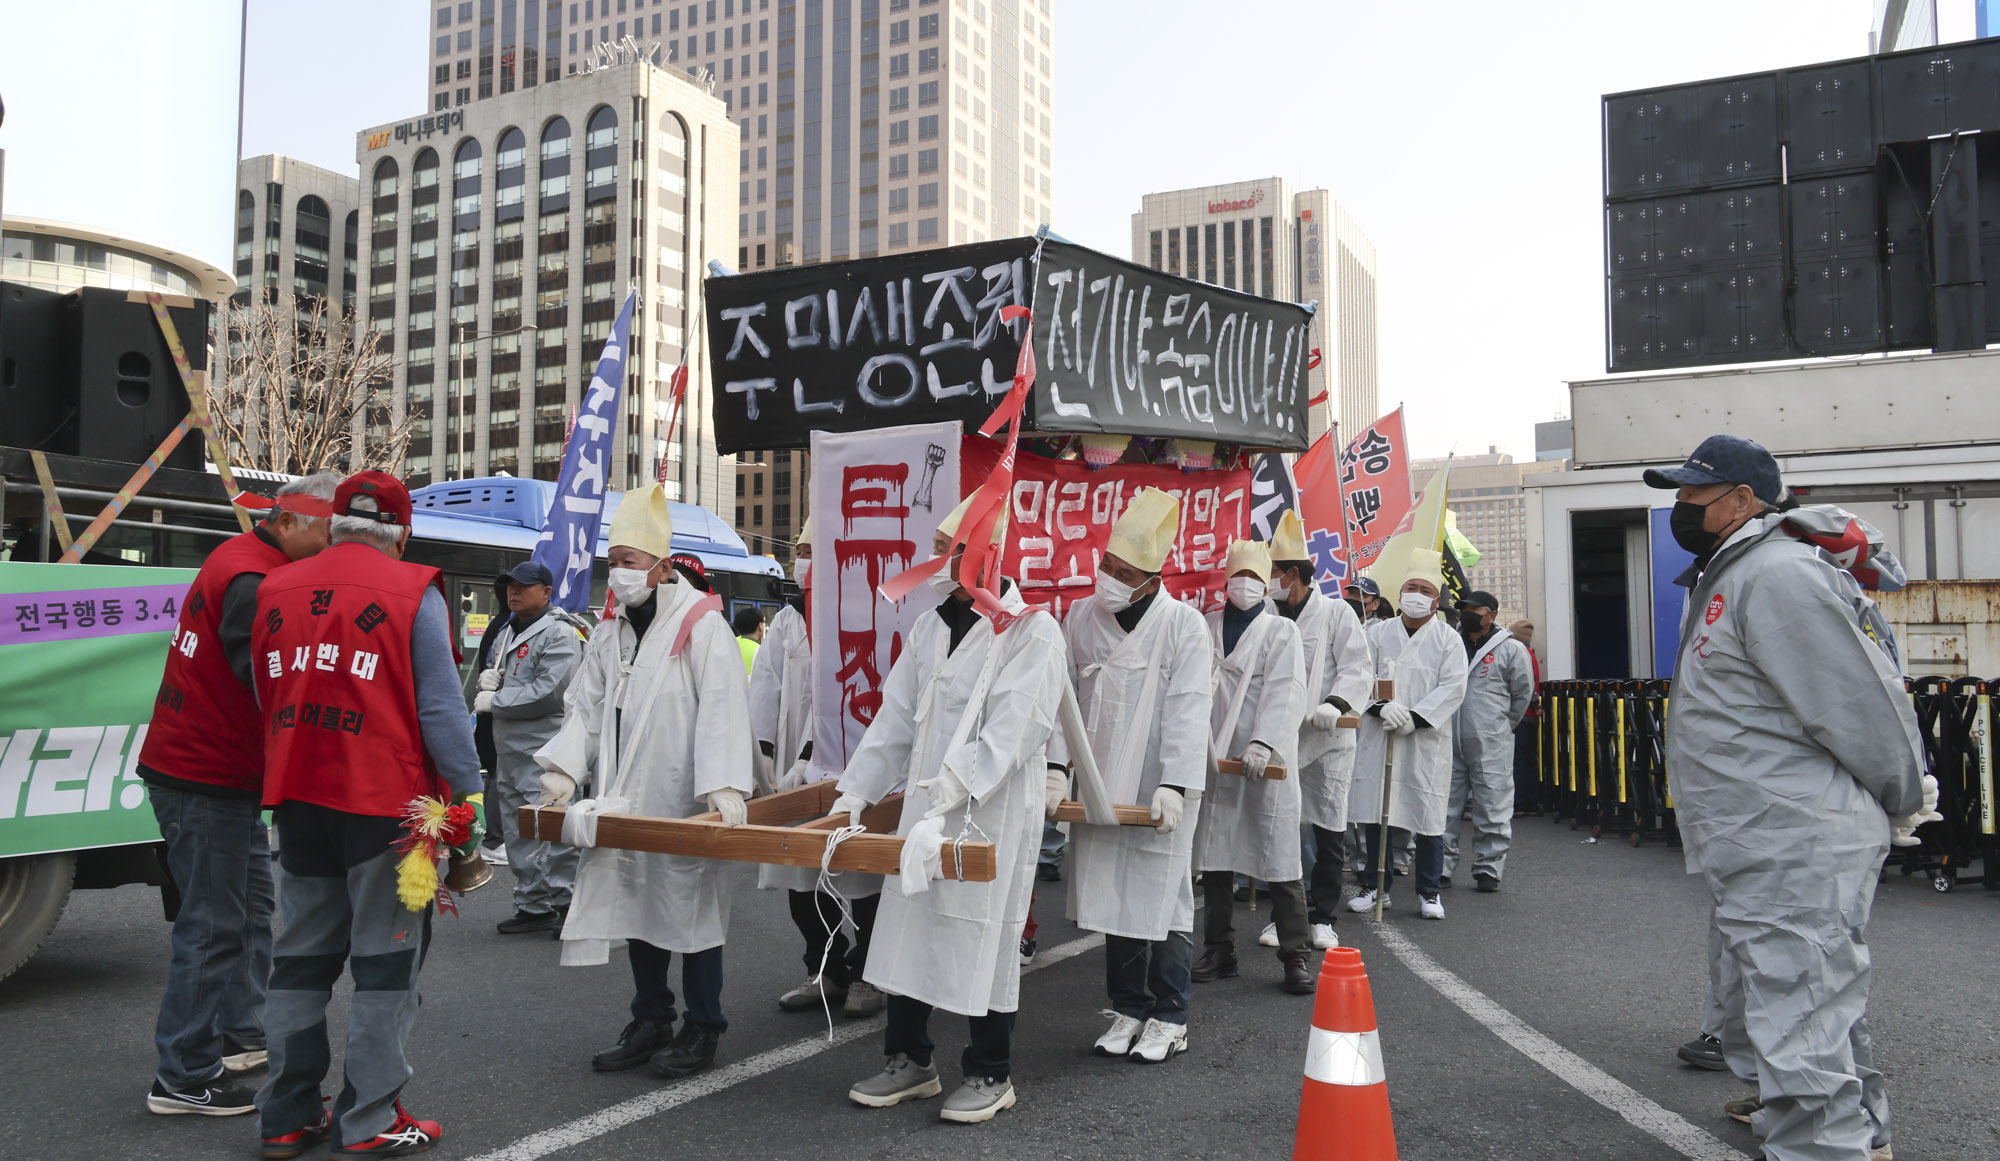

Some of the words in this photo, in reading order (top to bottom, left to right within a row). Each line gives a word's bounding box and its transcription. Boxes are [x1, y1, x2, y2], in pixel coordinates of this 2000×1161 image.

[367, 130, 391, 151] MT
[395, 109, 463, 144] 머니투데이
[1208, 198, 1255, 213] kobaco
[1305, 223, 1322, 284] 서울신문
[15, 599, 124, 632] 전국행동
[135, 597, 177, 621] 3.4
[267, 643, 379, 680] 결사반대
[302, 703, 364, 736] 어물리
[1978, 719, 1986, 774] POLICE
[1981, 783, 1989, 820] LINE
